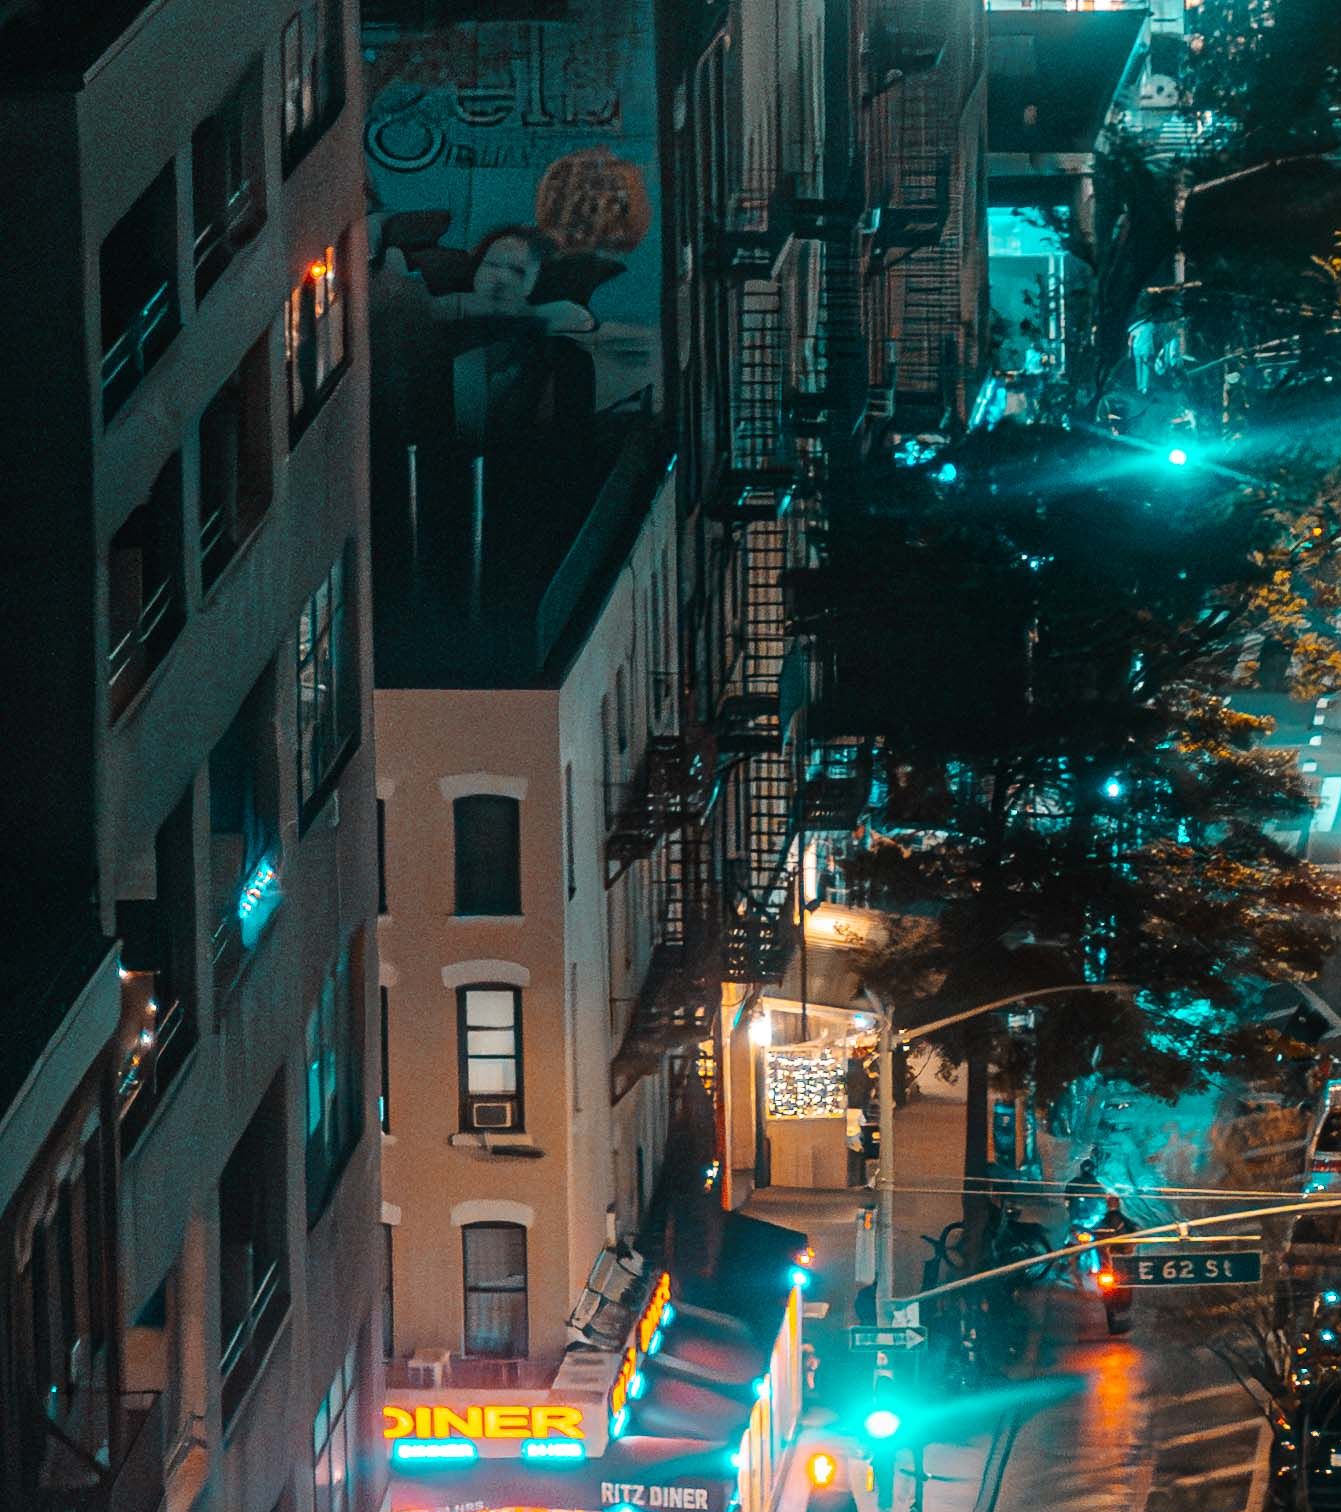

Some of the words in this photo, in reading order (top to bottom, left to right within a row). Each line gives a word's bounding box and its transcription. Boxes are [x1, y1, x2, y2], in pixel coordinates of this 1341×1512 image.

[1138, 1262, 1153, 1280] E
[1162, 1260, 1195, 1279] 62
[1205, 1259, 1233, 1278] St
[383, 1405, 585, 1439] DINER
[601, 1481, 645, 1506] RITZ
[649, 1486, 708, 1510] DINER
